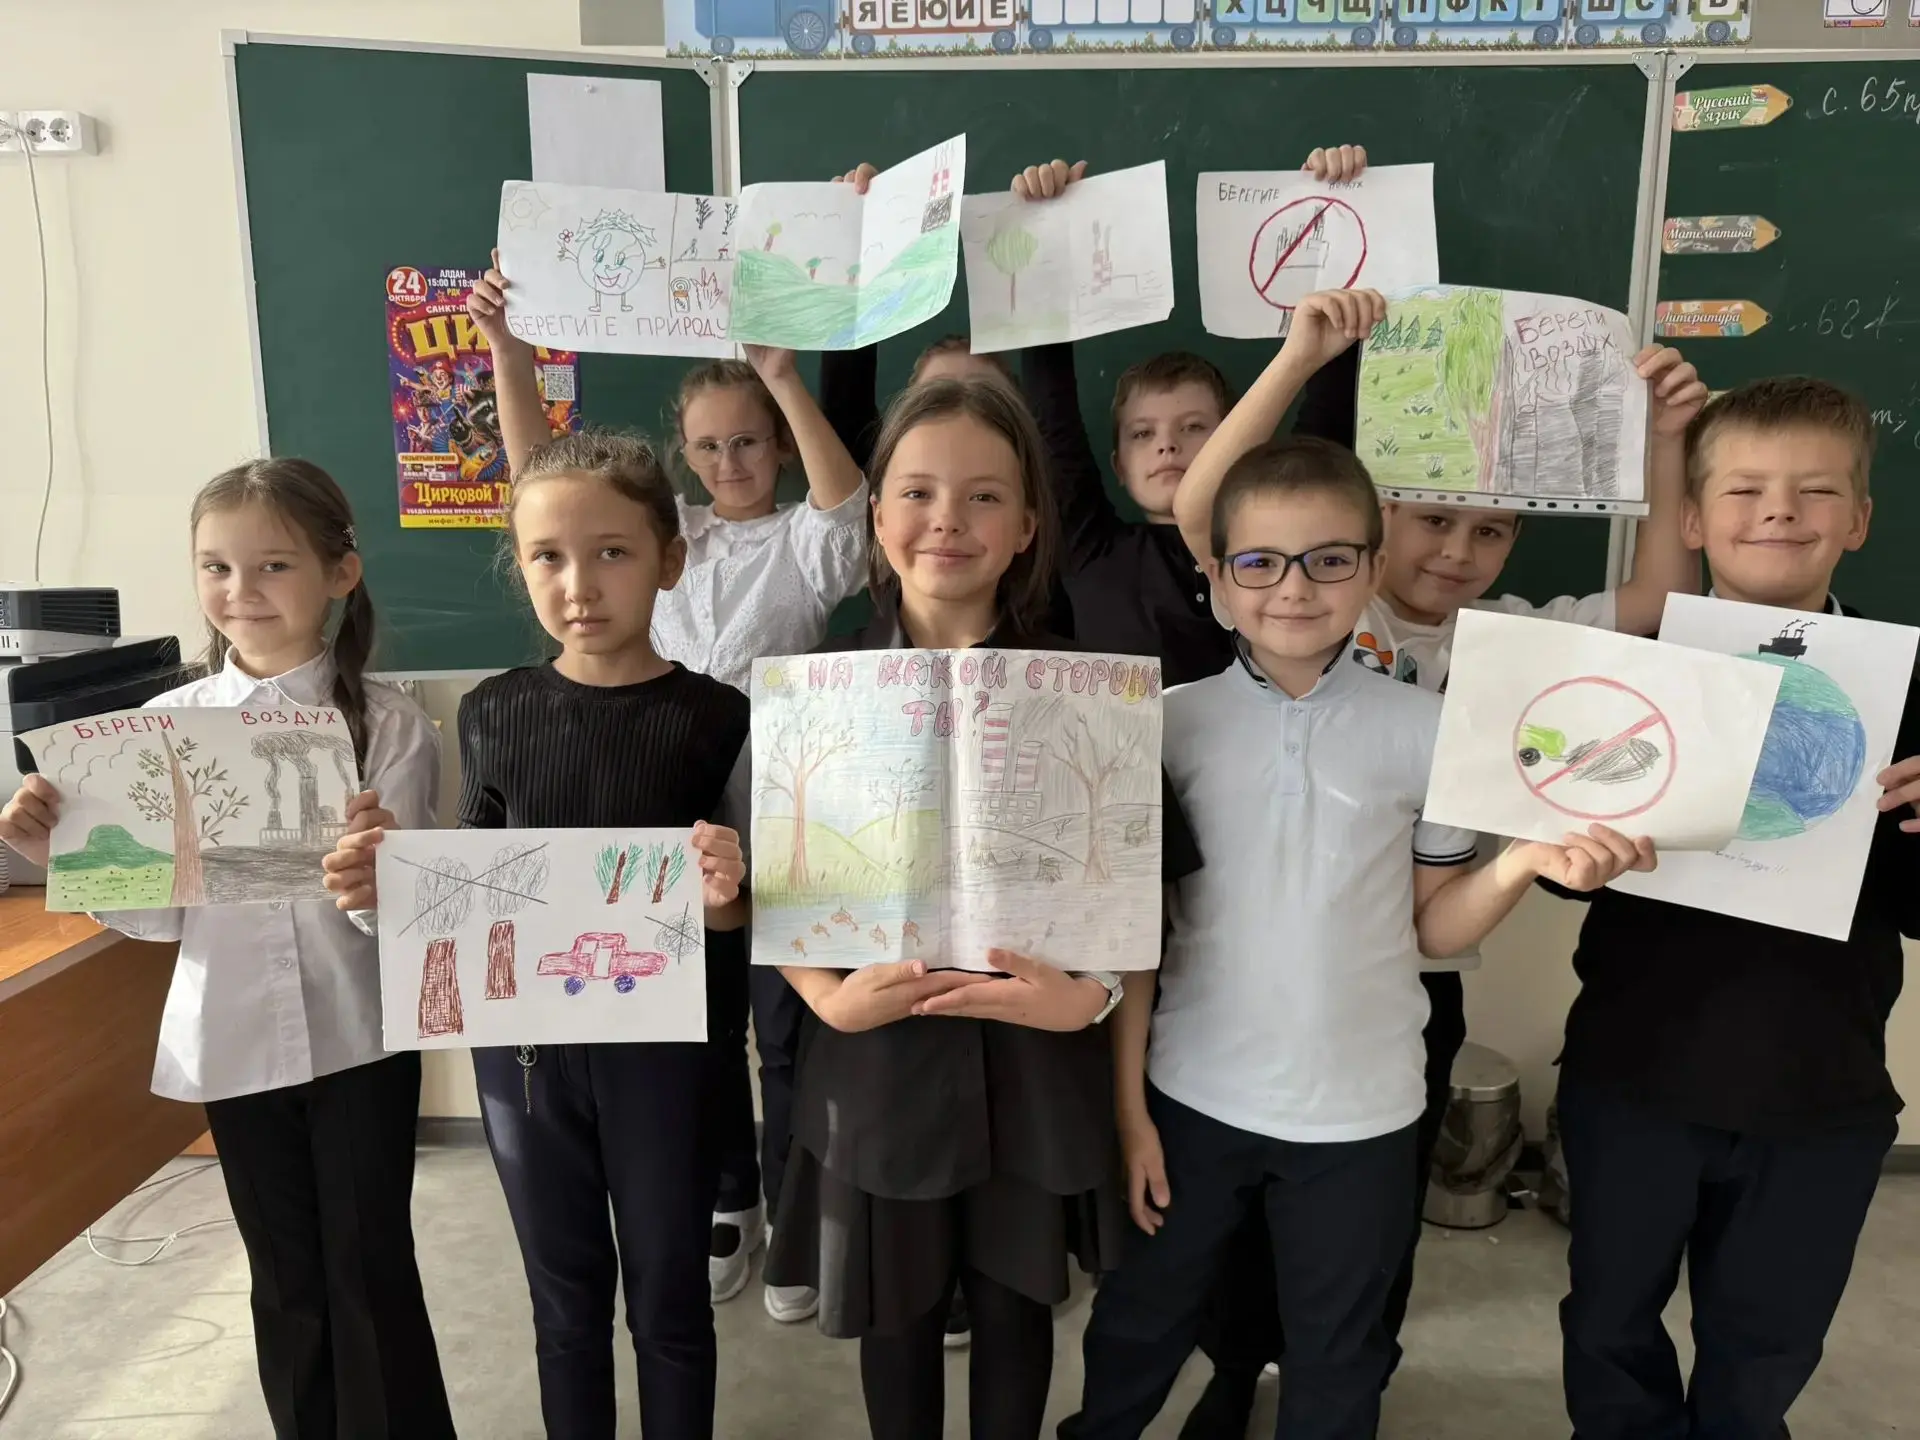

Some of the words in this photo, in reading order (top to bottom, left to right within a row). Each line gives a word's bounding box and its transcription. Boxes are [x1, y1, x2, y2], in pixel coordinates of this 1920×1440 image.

[1693, 93, 1750, 111] Русский
[1704, 110, 1742, 125] язык
[1218, 182, 1280, 204] БЕРЕГИТЕ
[1667, 229, 1753, 239] Математика
[440, 269, 465, 279] АЛДАН
[391, 270, 421, 294] 24
[428, 278, 449, 287] 15:00
[450, 279, 456, 287] И
[458, 279, 475, 288] 18:0
[388, 294, 427, 302] ОКТЯБРЯ
[447, 288, 460, 297] РДК
[426, 304, 467, 313] САНКТ-П
[508, 313, 618, 338] БЕРЕГИТЕ
[1660, 311, 1742, 325] Литература
[405, 313, 492, 362] ЦИ
[808, 656, 853, 690] НА
[877, 651, 1008, 689] КАКОЙ
[74, 714, 175, 739] БЕРЕГИ
[241, 710, 337, 726] ВОЗДУХ
